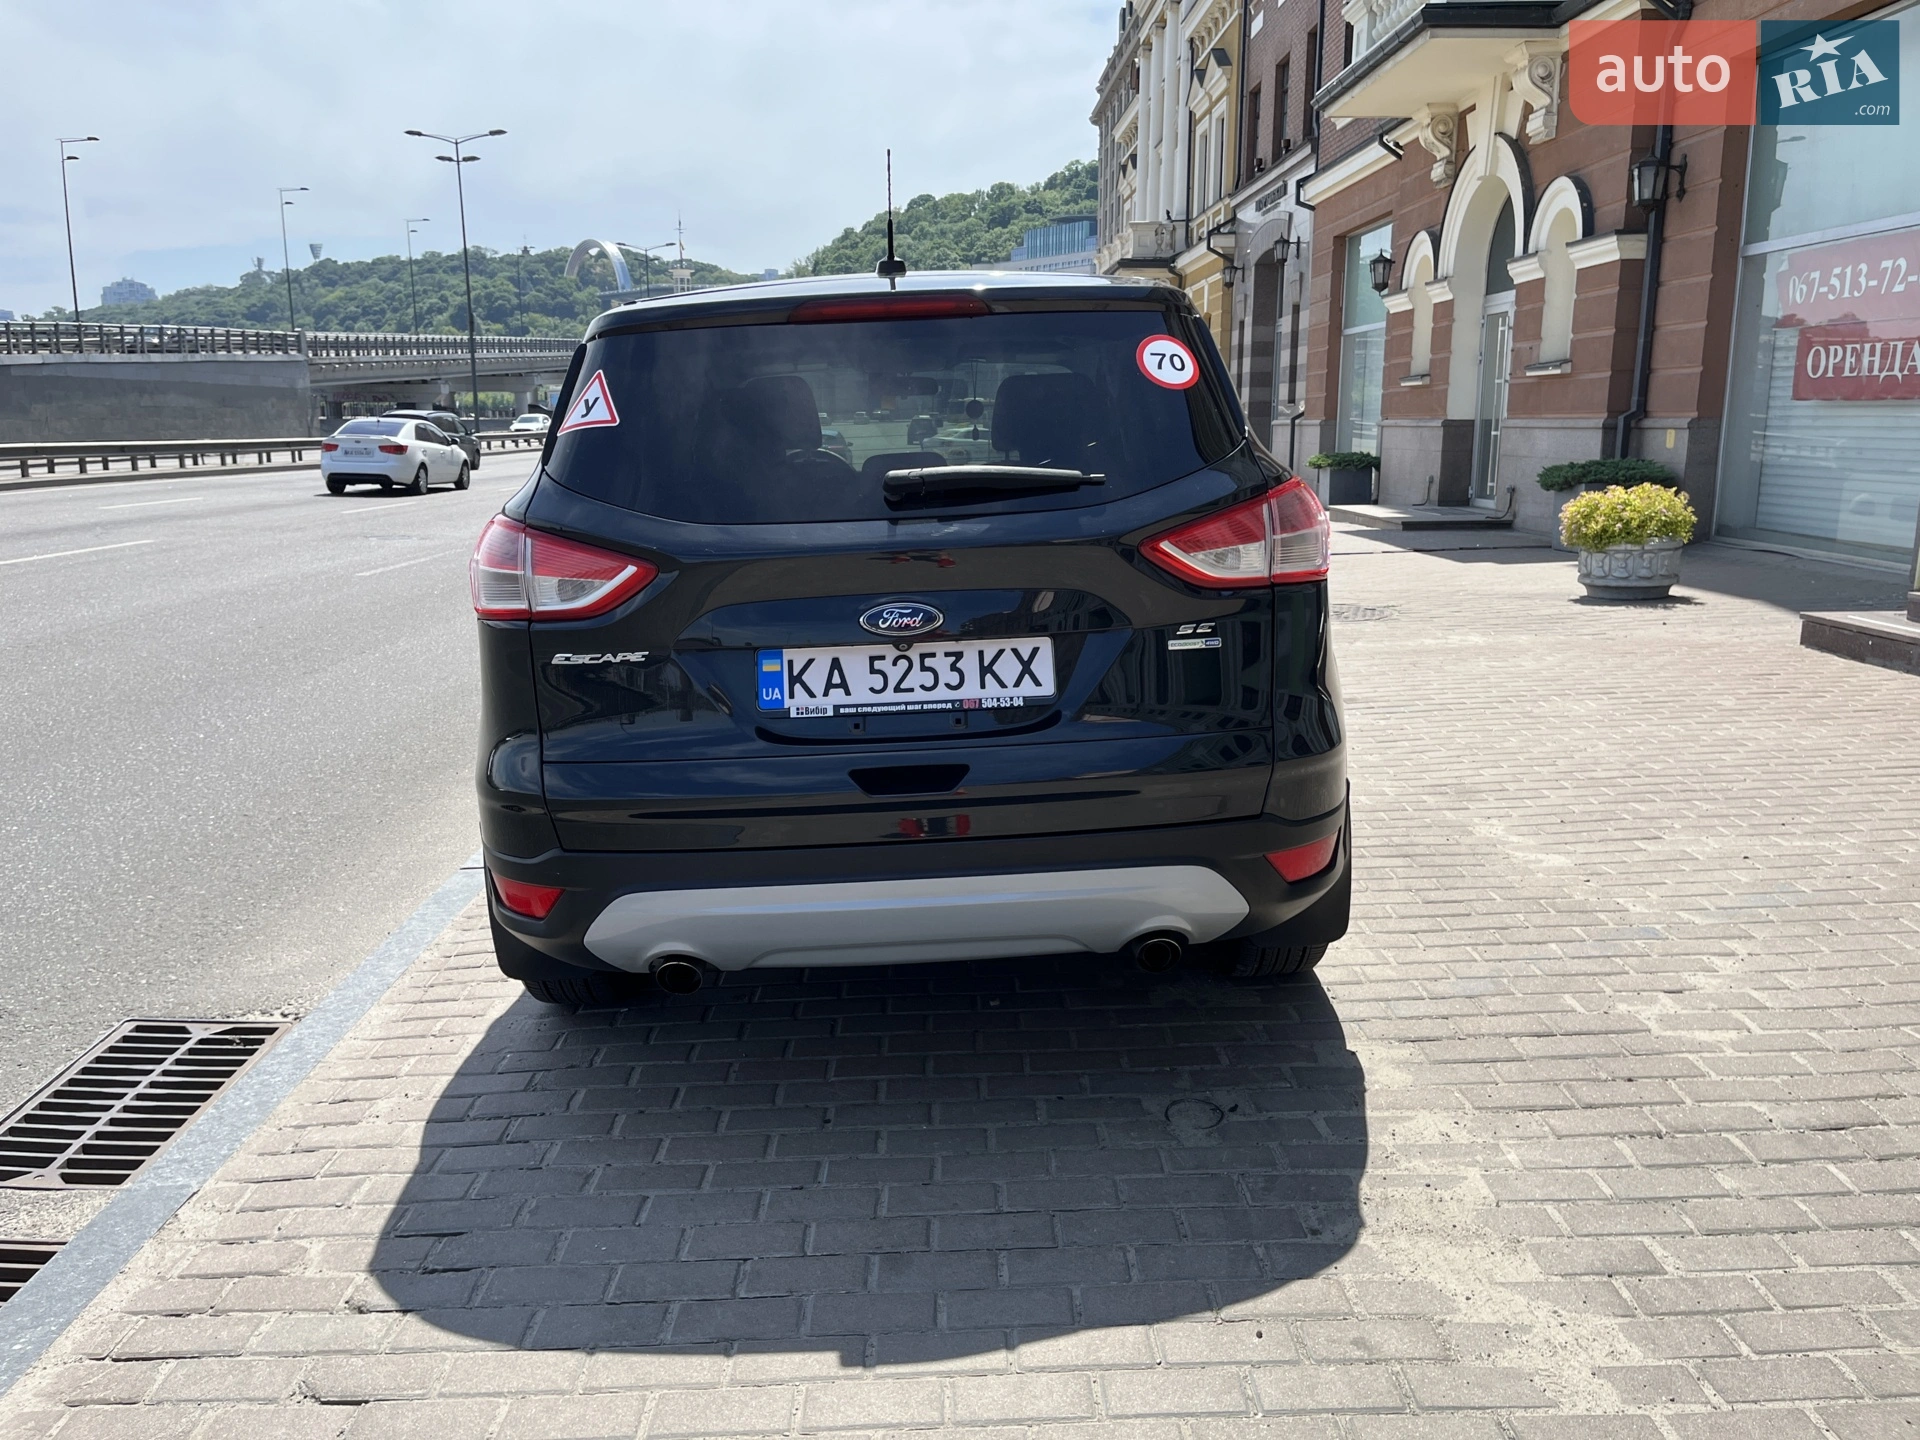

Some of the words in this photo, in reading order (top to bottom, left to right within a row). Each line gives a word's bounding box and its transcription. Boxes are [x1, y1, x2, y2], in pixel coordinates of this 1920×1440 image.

[1789, 257, 1920, 306] 067-513-72-
[1150, 352, 1186, 372] 70
[1806, 340, 1920, 384] ОРЕНДА
[878, 608, 924, 629] Ford
[551, 651, 649, 664] ESCAPE
[787, 657, 851, 699] KA
[868, 651, 965, 693] 5253
[978, 647, 1042, 690] KX
[762, 688, 782, 701] UA
